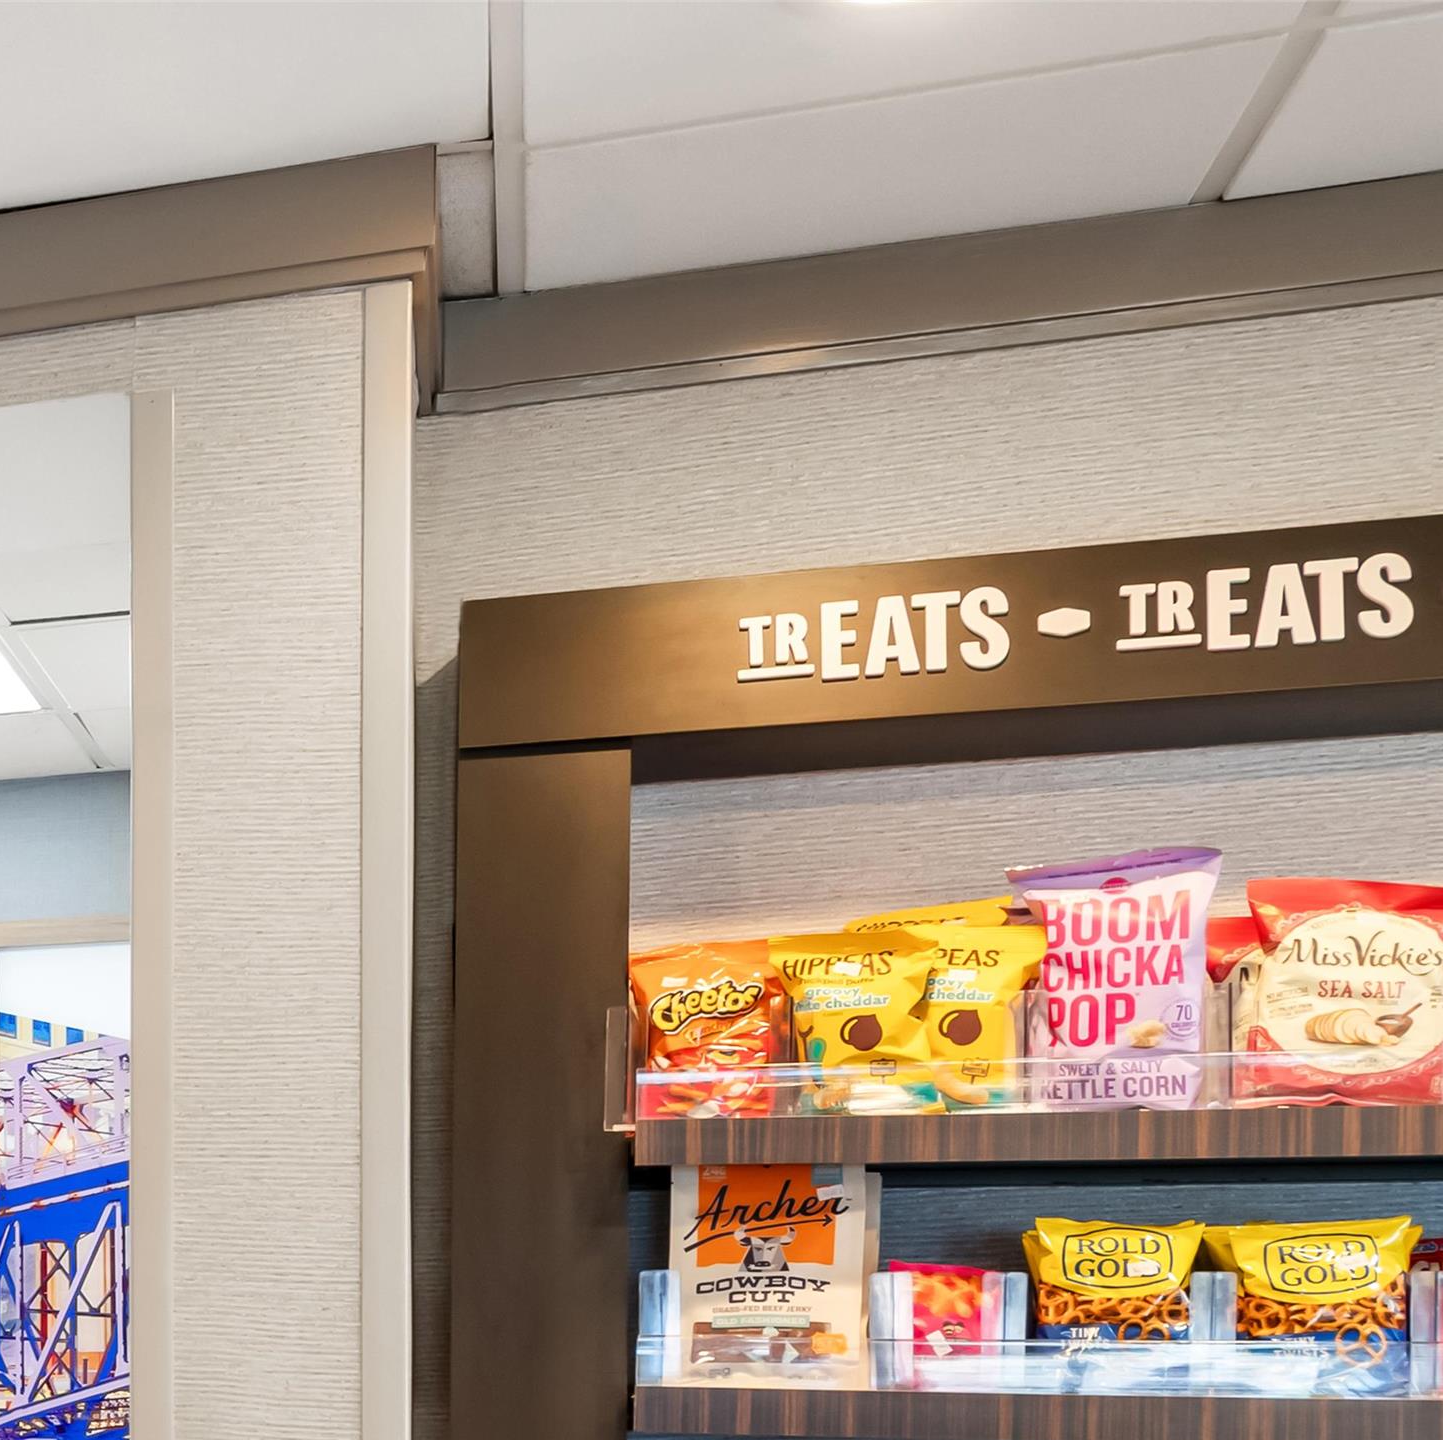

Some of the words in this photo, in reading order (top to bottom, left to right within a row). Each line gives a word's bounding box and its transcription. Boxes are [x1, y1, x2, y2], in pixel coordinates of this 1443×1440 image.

[737, 586, 1011, 682] TREATS
[1116, 552, 1414, 652] TREATS
[1043, 889, 1191, 950] BOOM
[933, 949, 1001, 968] PEAS
[1282, 938, 1353, 967] Miss
[1345, 930, 1443, 976] Vickie's
[1043, 944, 1185, 993] CHICKA
[805, 986, 861, 1004] groovy
[928, 990, 994, 1002] cheddar
[1317, 979, 1354, 999] SEA
[1361, 980, 1407, 999] SALT
[651, 980, 762, 1032] Cheetos
[825, 995, 890, 1010] cheddar
[1176, 1004, 1193, 1021] 70
[1048, 992, 1136, 1050] POP
[1058, 1062, 1102, 1077] SWEET
[1106, 1062, 1116, 1076] &
[1121, 1060, 1164, 1075] SALTY
[1041, 1077, 1116, 1100] KETTLE
[1122, 1074, 1187, 1098] CORN
[684, 1180, 851, 1241] Archer
[1075, 1236, 1161, 1257] ROLD
[696, 1275, 831, 1295] COWBOY
[728, 1290, 796, 1304] CUT
[1070, 1326, 1101, 1339] TINY
